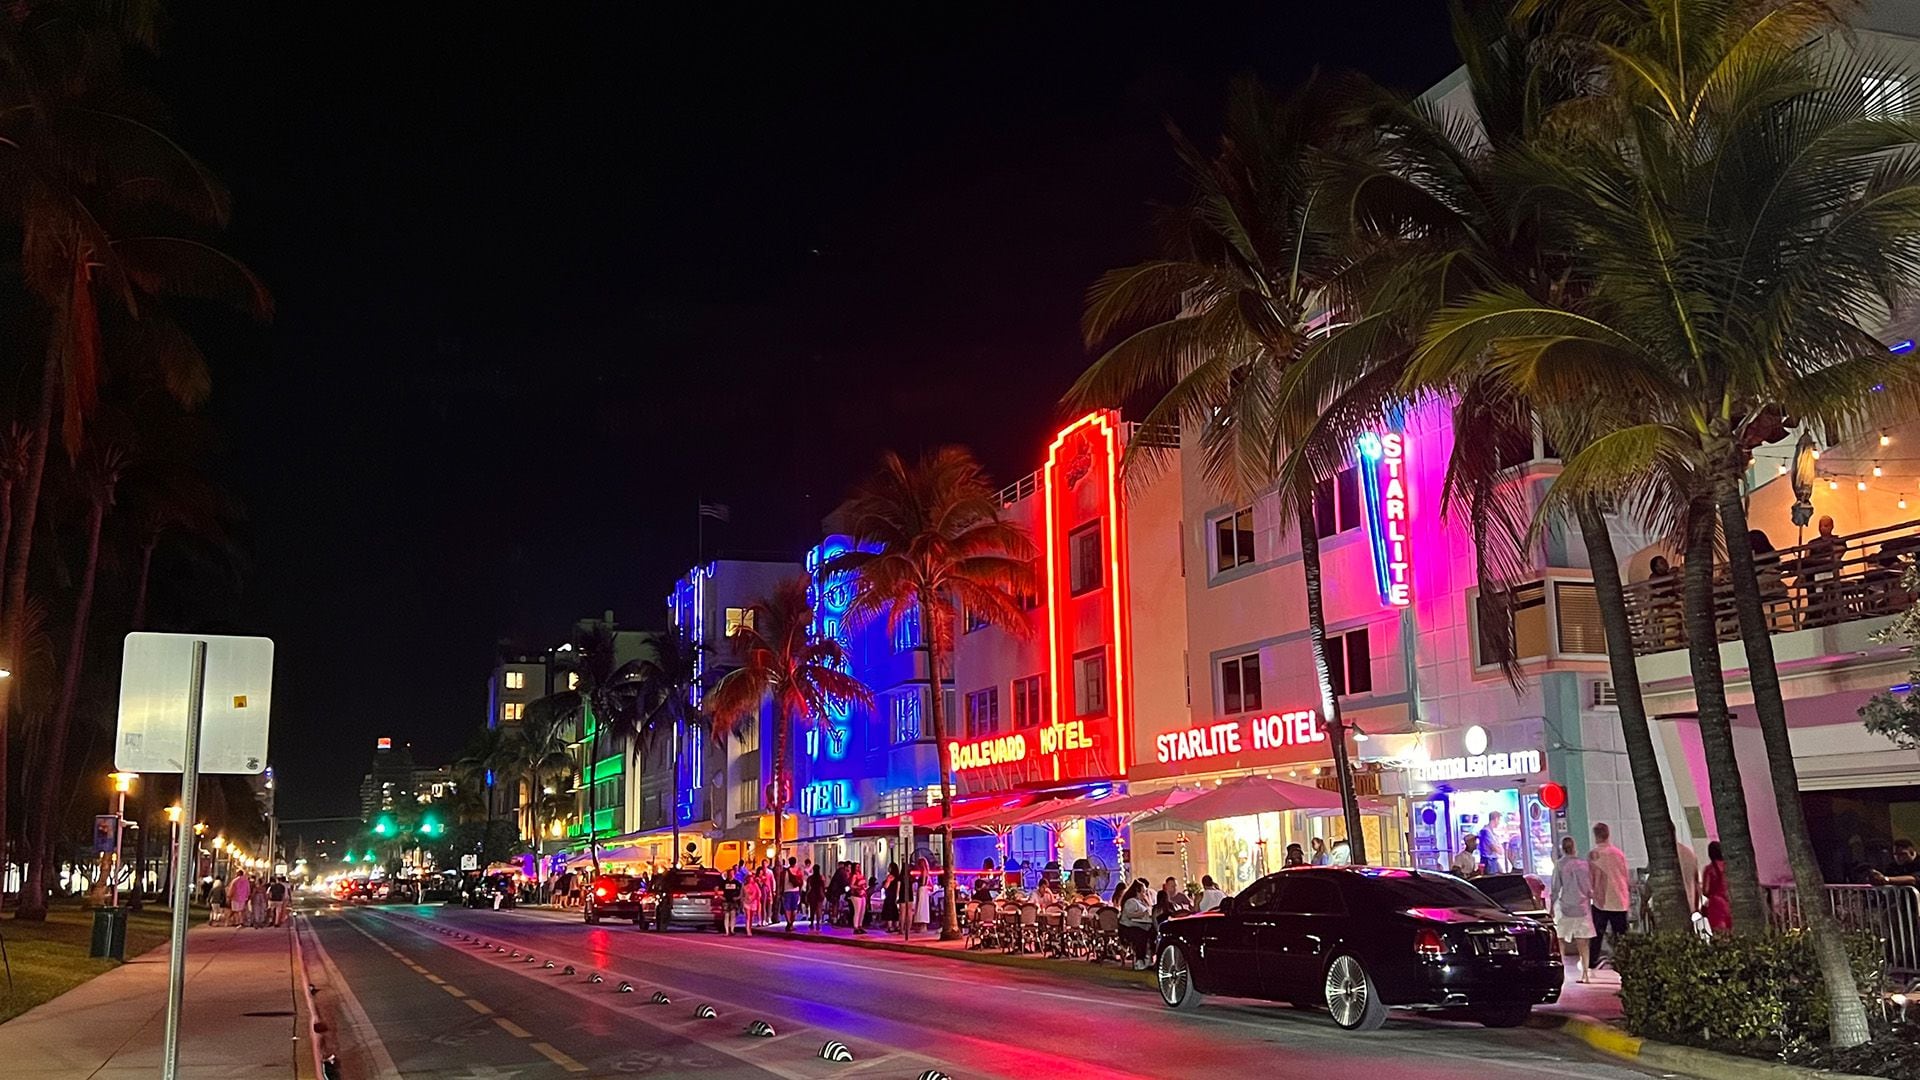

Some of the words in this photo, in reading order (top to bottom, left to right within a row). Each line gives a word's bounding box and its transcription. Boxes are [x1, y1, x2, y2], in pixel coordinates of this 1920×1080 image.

[1381, 432, 1410, 606] STARLITE
[825, 548, 850, 755] OLNY
[949, 734, 1026, 772] BOULEVARD
[1040, 720, 1093, 755] HOTEL
[1156, 722, 1242, 763] STARLITE
[1252, 709, 1325, 750] HOTEL
[1487, 749, 1541, 777] GELATO
